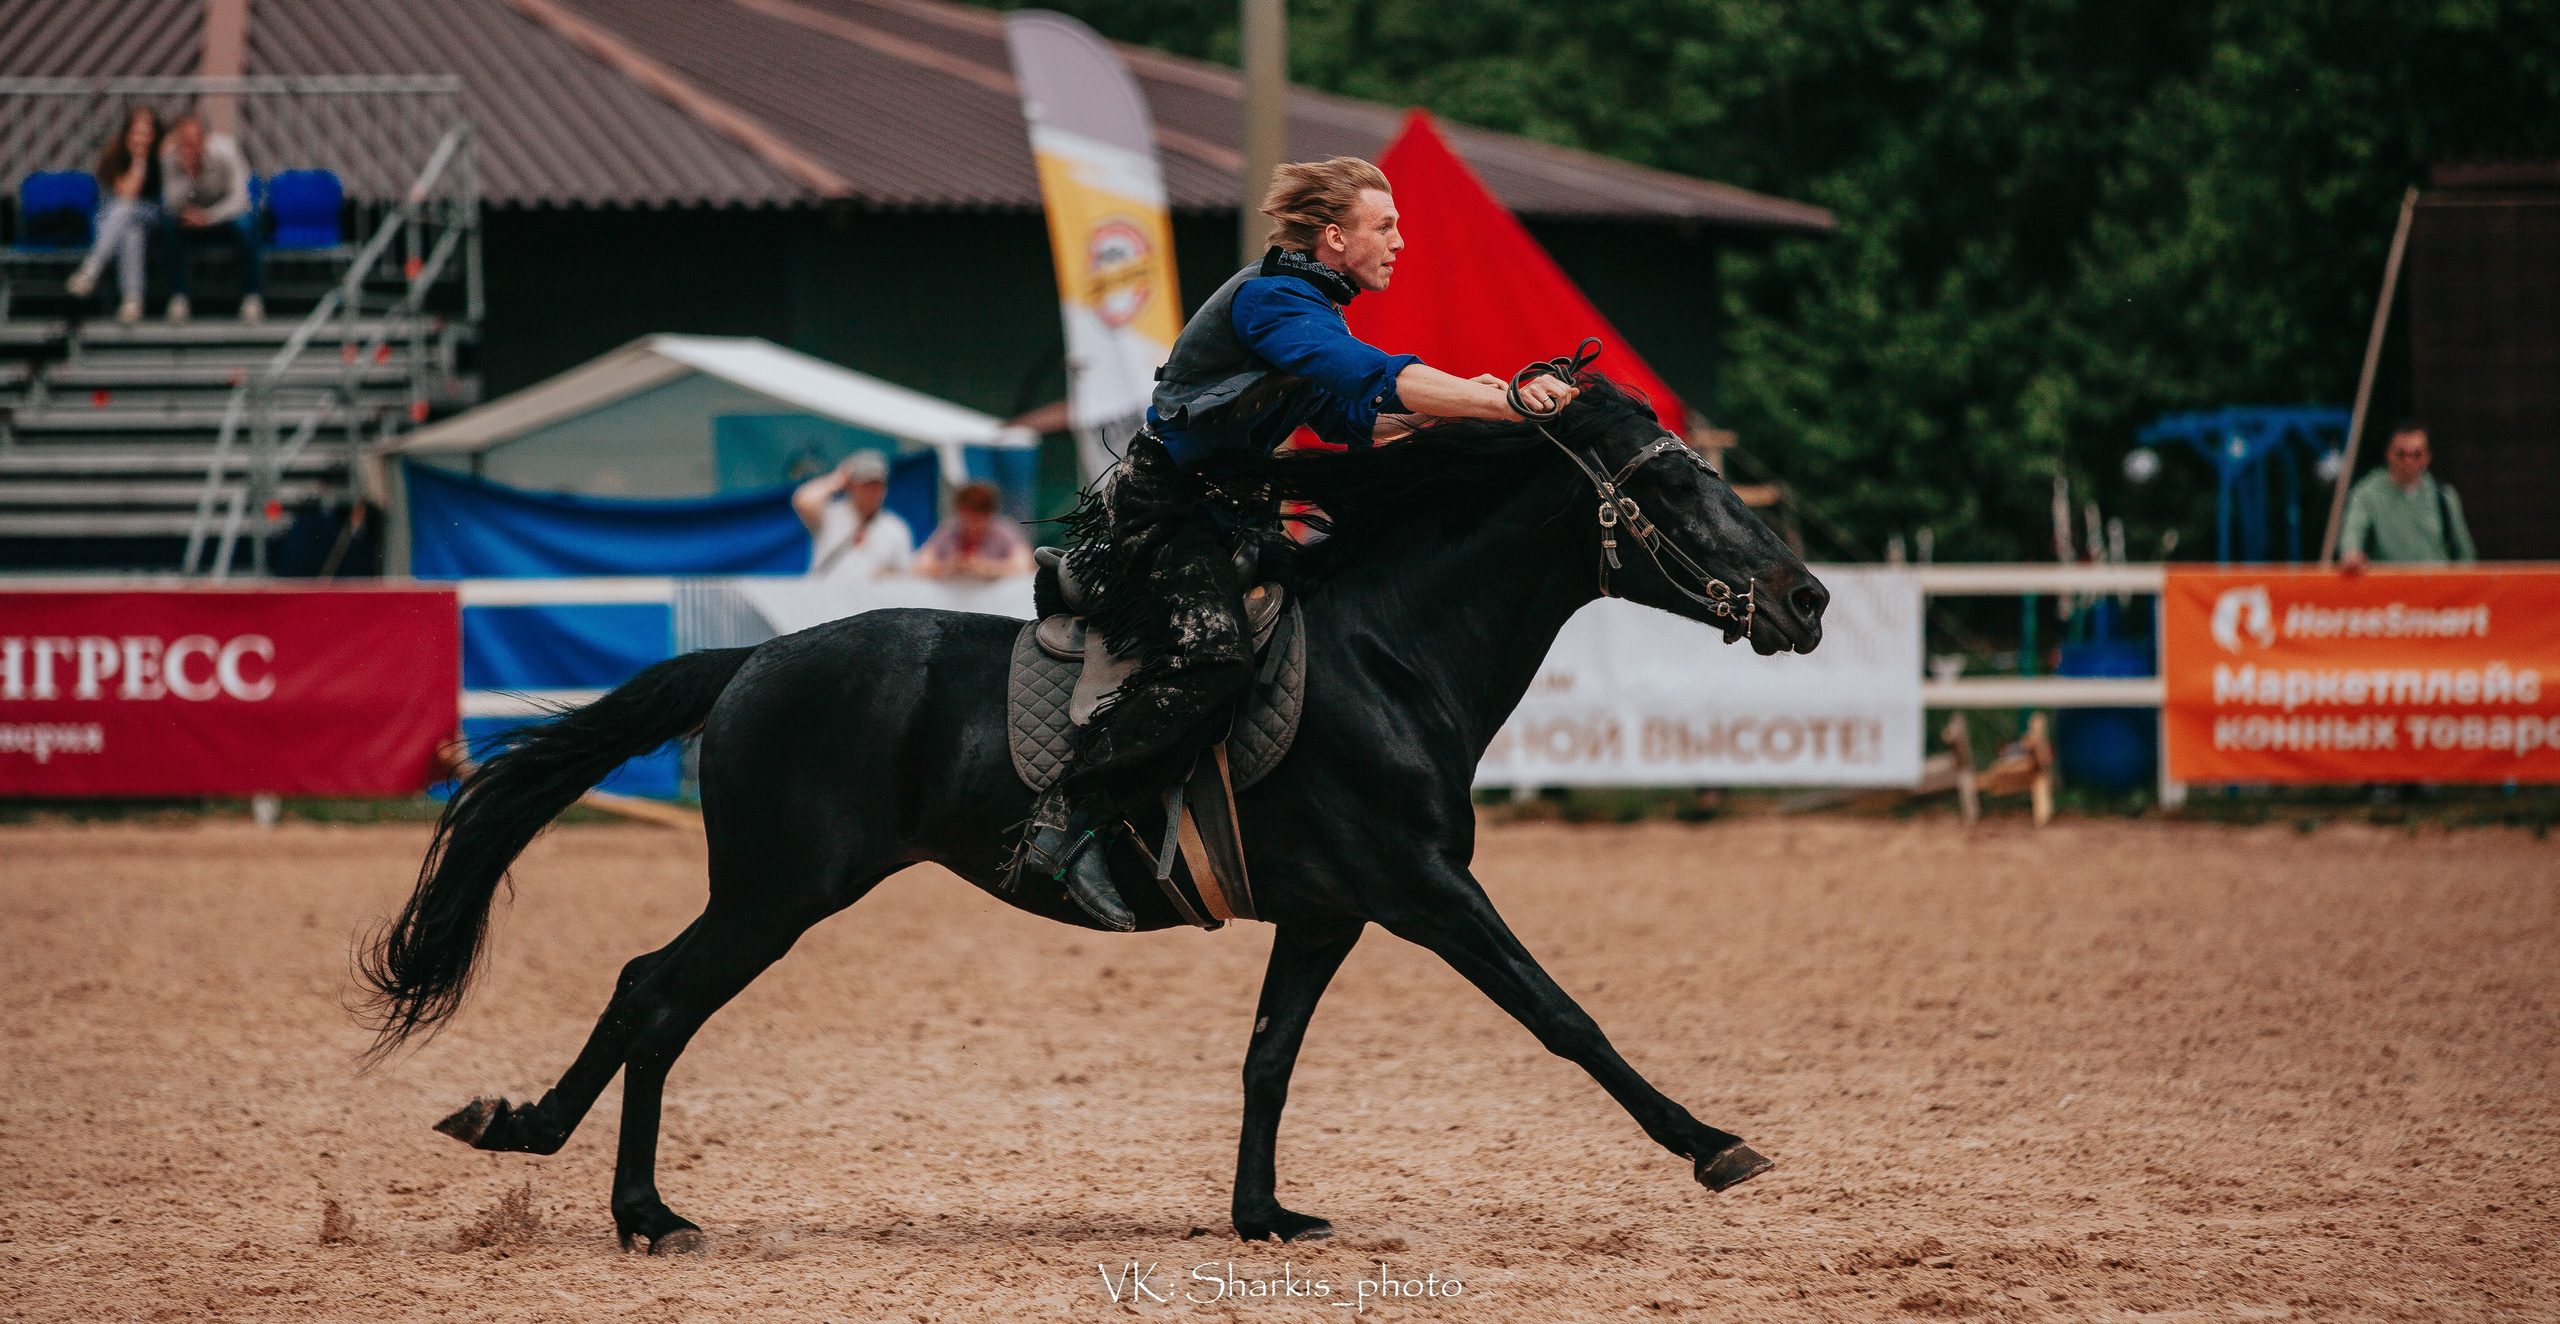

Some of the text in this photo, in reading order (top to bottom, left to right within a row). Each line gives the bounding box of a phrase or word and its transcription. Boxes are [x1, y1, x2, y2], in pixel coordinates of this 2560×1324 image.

[2285, 604, 2488, 638] HorseSmart
[2214, 661, 2541, 711] Маркетплейс
[2214, 715, 2396, 750] конных
